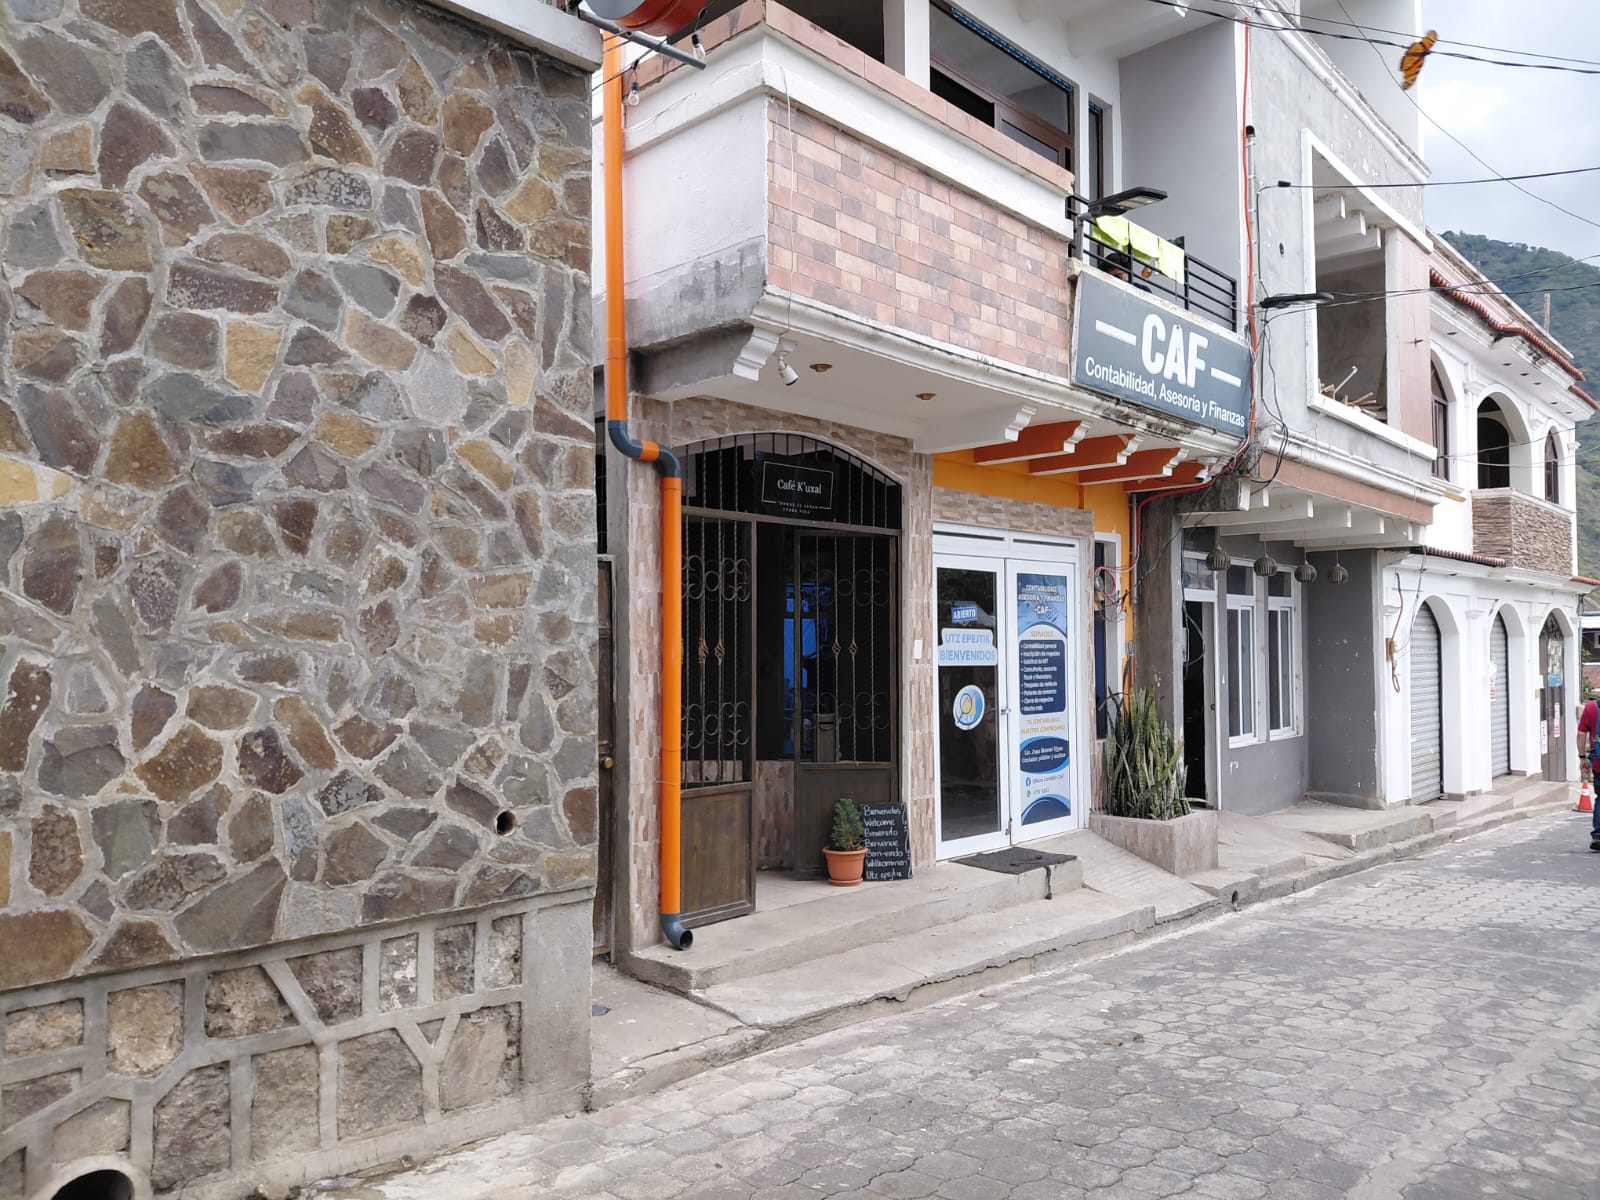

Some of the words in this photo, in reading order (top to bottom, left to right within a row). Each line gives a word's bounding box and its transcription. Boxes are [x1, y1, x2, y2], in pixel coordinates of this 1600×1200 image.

[1141, 313, 1209, 388] CAF
[1084, 356, 1157, 400] Contabilidad,
[1201, 401, 1208, 418] y
[1208, 400, 1246, 428] Finanzas
[777, 479, 796, 491] Café
[797, 481, 822, 494] K'uxal
[952, 609, 976, 619] ABIERTO
[945, 633, 961, 644] UTZ
[940, 649, 996, 661] BIENVENIDOS
[864, 818, 896, 827] Welcome
[865, 858, 908, 868] Willkommen
[866, 870, 879, 880] Utz
